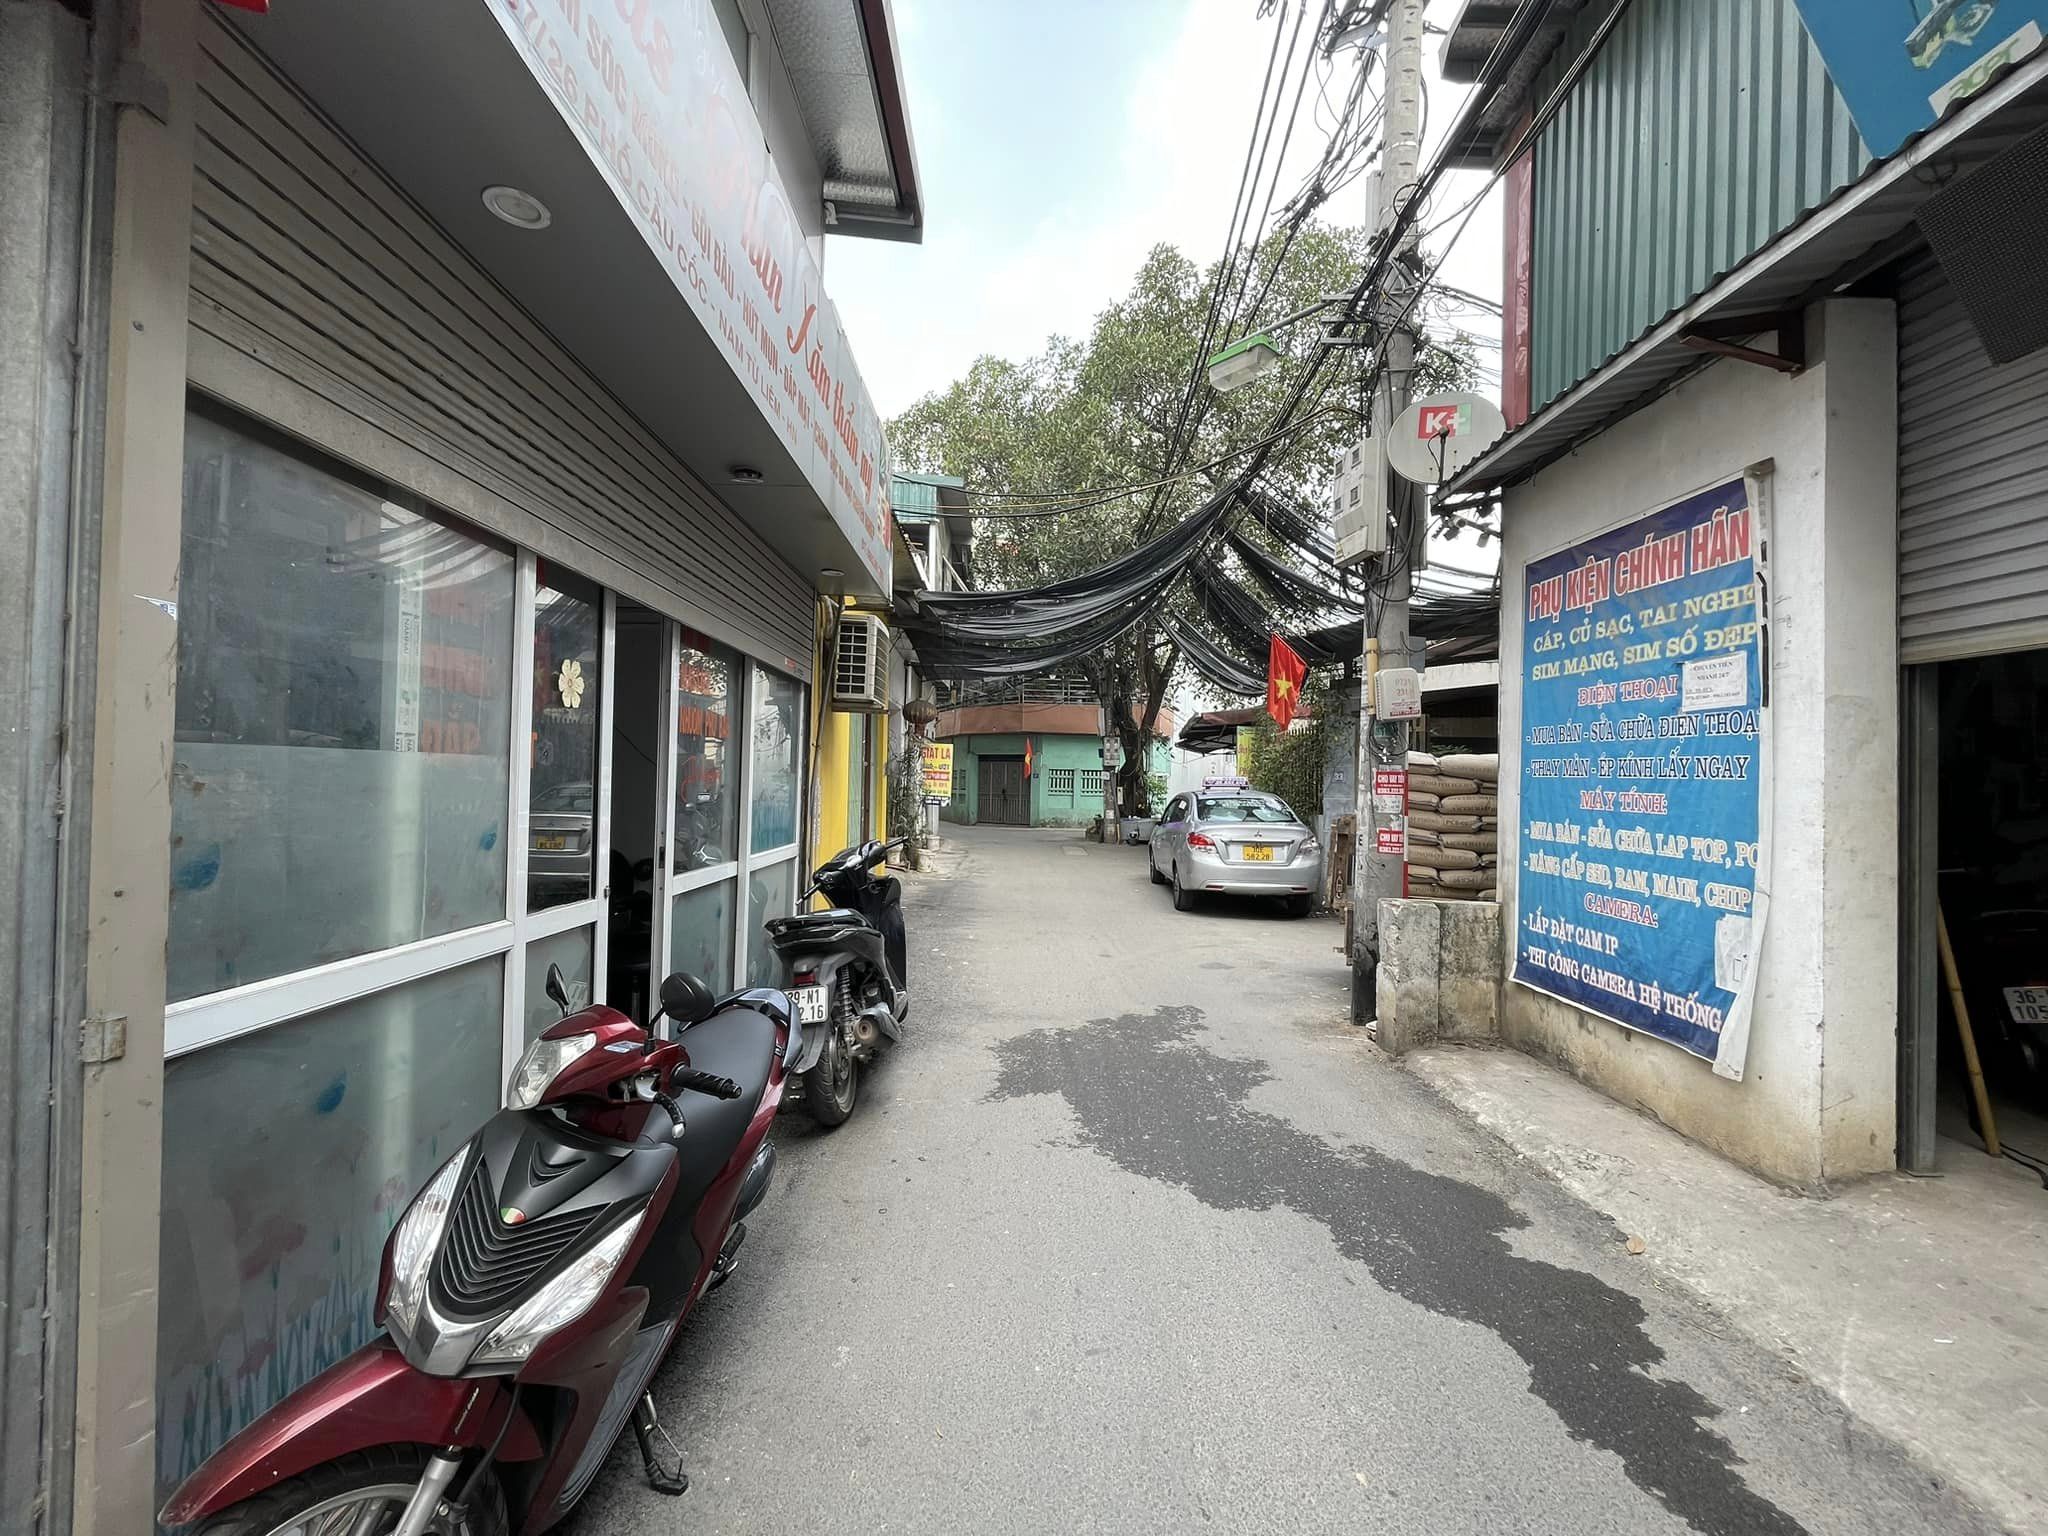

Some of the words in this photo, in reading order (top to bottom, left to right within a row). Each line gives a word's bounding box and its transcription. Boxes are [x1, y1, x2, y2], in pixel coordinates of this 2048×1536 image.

[677, 243, 709, 305] CỐC
[718, 314, 744, 361] NAM
[1529, 575, 1563, 623] PHỤ
[1565, 554, 1611, 613] KIỆN
[1615, 532, 1686, 597] CHÍNH
[1569, 617, 1591, 645] CỦ
[1595, 614, 1635, 638] SẠC,
[1638, 603, 1678, 629] TAI
[1532, 660, 1561, 681] SIM
[1563, 652, 1619, 676] MẠNG,
[1622, 642, 1661, 665] SIM
[1665, 624, 1699, 656] SỐ
[1703, 621, 1758, 654] ĐẸP
[1578, 679, 1617, 709] ĐIỆN
[1620, 674, 1679, 703] THOẠI
[1532, 726, 1555, 745] MUA
[1558, 717, 1583, 743] BÁN
[1590, 712, 1615, 742] SỬA
[1617, 712, 1654, 741] CHỮA
[1658, 714, 1700, 744] ĐIỆN
[1704, 710, 1760, 741] THOẠ
[1531, 759, 1561, 778] THAY
[1562, 754, 1590, 778] MÀN
[1598, 752, 1616, 778] ÉP
[1616, 754, 1653, 779] KÍNH
[1656, 748, 1690, 780] LẤY
[1694, 754, 1750, 781] NGAY
[1580, 786, 1616, 812] MÁY
[1618, 786, 1668, 815] TÍNH:
[1530, 821, 1555, 843] MUA
[1555, 819, 1580, 845] BÁN
[1587, 820, 1613, 849] SỬA
[1615, 826, 1654, 854] CHỮA
[1656, 833, 1688, 860] LAP
[1691, 837, 1731, 869] TOP,
[1529, 850, 1560, 877] NÂNG
[1560, 851, 1585, 881] CẤP
[1586, 864, 1612, 888] SSD,
[1614, 869, 1650, 897] RAM,
[1652, 874, 1701, 908] MAIN,
[1704, 882, 1752, 913] CHIP
[1528, 907, 1549, 932] LẮP
[1550, 917, 1575, 944] ĐẶT
[1575, 927, 1603, 952] CAM
[1604, 937, 1619, 957] IP
[1583, 892, 1659, 929] CAMERA:
[1528, 946, 1547, 968] THI
[1548, 953, 1579, 978] CÔNG
[1581, 963, 1638, 1000] CAMERA
[1639, 980, 1662, 1016] HỆ
[1662, 989, 1723, 1033] THỐNG
